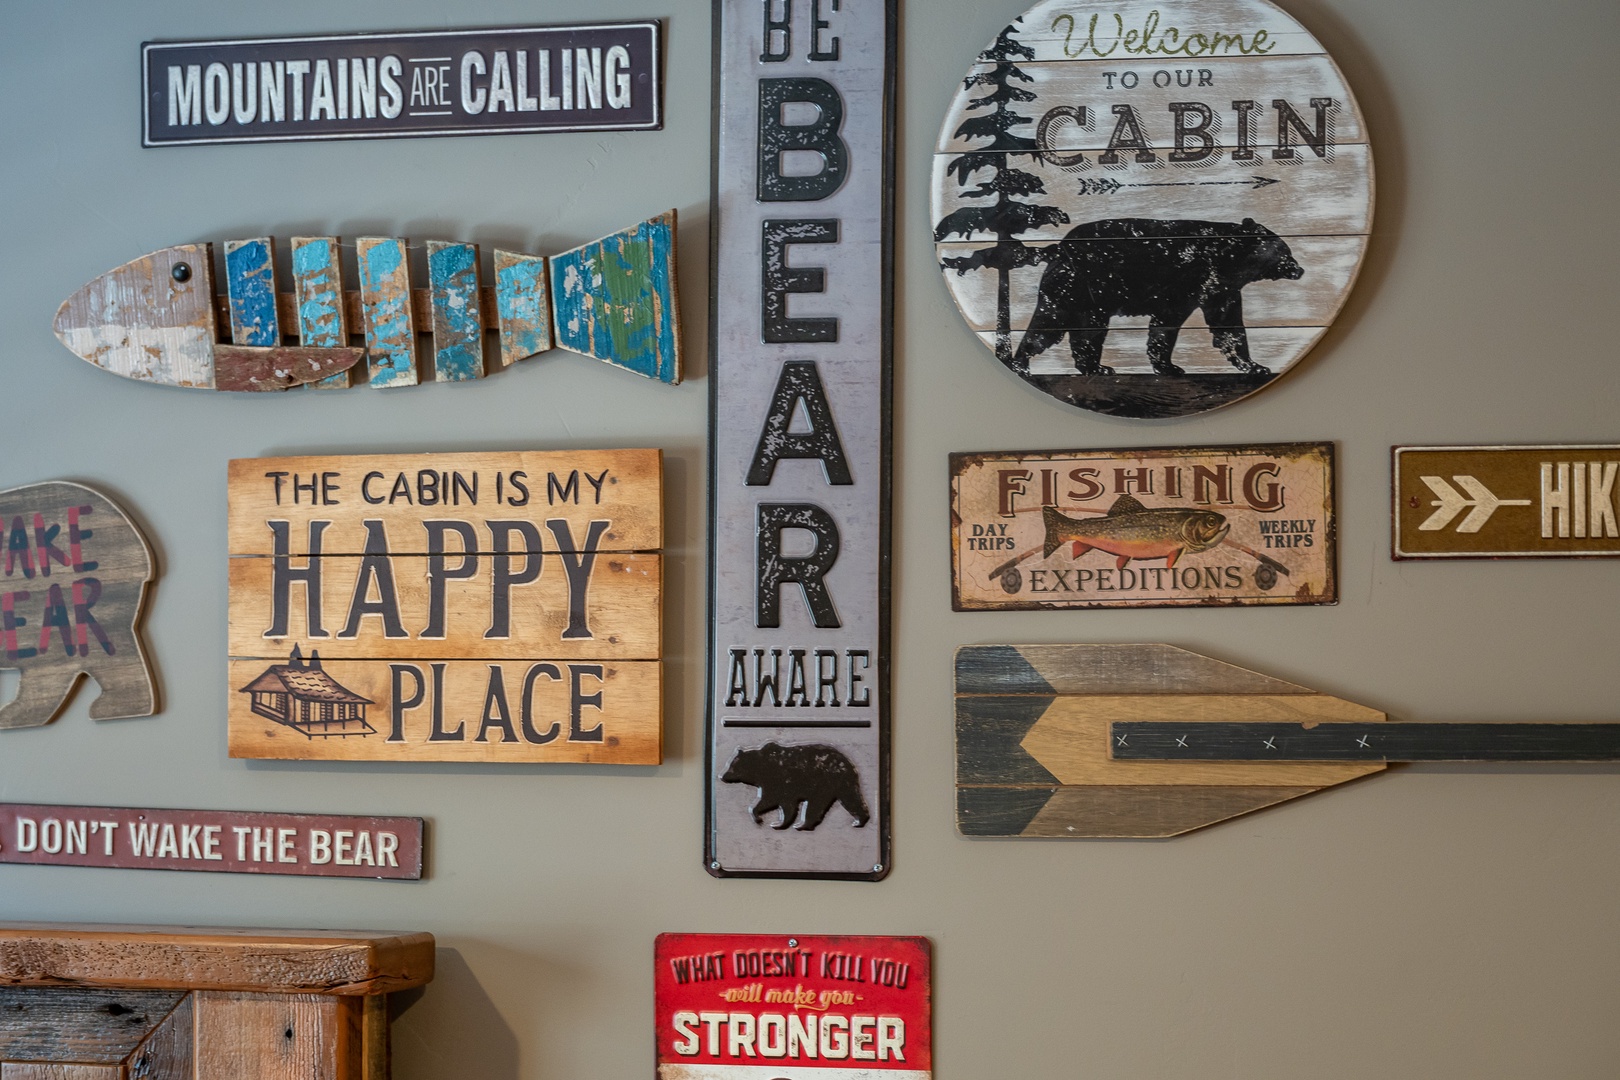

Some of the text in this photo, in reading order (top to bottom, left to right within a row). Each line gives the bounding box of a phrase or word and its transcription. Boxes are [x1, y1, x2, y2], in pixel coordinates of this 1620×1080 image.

[759, 0, 839, 62] BE
[1051, 10, 1276, 59] Welcome
[167, 44, 632, 126] MOUNTAINS ARE CALLING
[1102, 69, 1214, 90] TO OUR
[1035, 97, 1343, 173] CABIN
[744, 77, 854, 627] BEAR
[265, 469, 610, 507] THE CABIN IS MY
[996, 462, 1286, 517] FISHING
[0, 505, 99, 579] AKE
[967, 537, 1015, 551] TRIPS
[972, 523, 1008, 537] DAY
[1259, 519, 1316, 534] WEEKLY
[1263, 534, 1314, 548] TRIPS
[262, 518, 612, 641] HAPPY
[1029, 565, 1243, 593] EXPEDITIONS
[0, 577, 116, 661] EAR
[724, 646, 871, 707] AWARE
[384, 662, 605, 745] PLACE
[16, 818, 400, 868] DON'T WAKE THE BEAR
[671, 949, 910, 989] WHAT DOESN'T KILL YOU
[765, 984, 816, 1004] make
[673, 1011, 907, 1062] STRONGER
